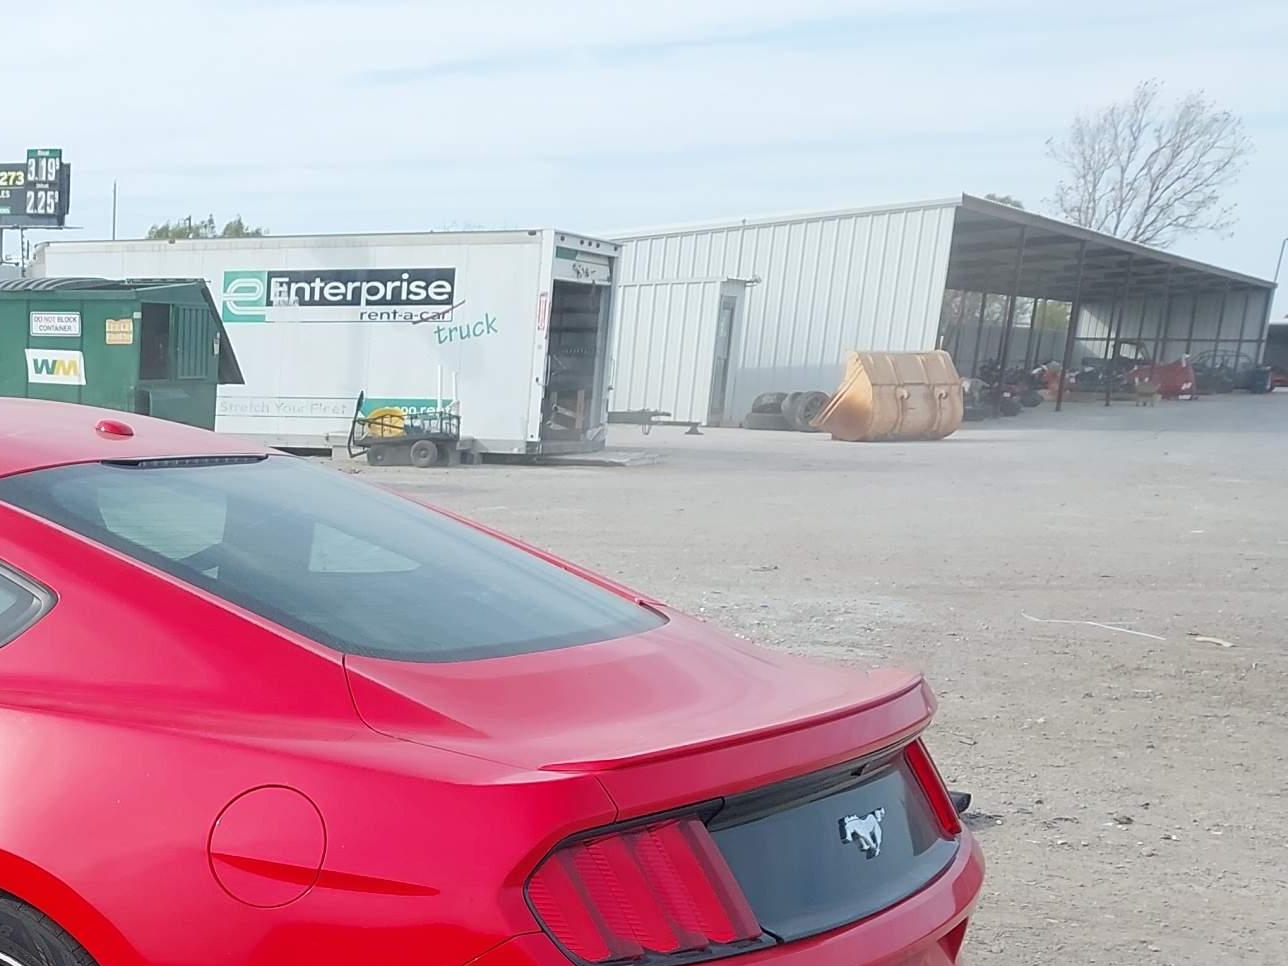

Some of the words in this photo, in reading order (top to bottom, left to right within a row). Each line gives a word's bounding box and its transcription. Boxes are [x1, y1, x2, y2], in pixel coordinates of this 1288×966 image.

[270, 273, 453, 309] Enterprise
[360, 307, 450, 322] rent-a-car
[434, 313, 499, 345] truck
[33, 358, 78, 375] WM
[220, 399, 270, 414] Stretch
